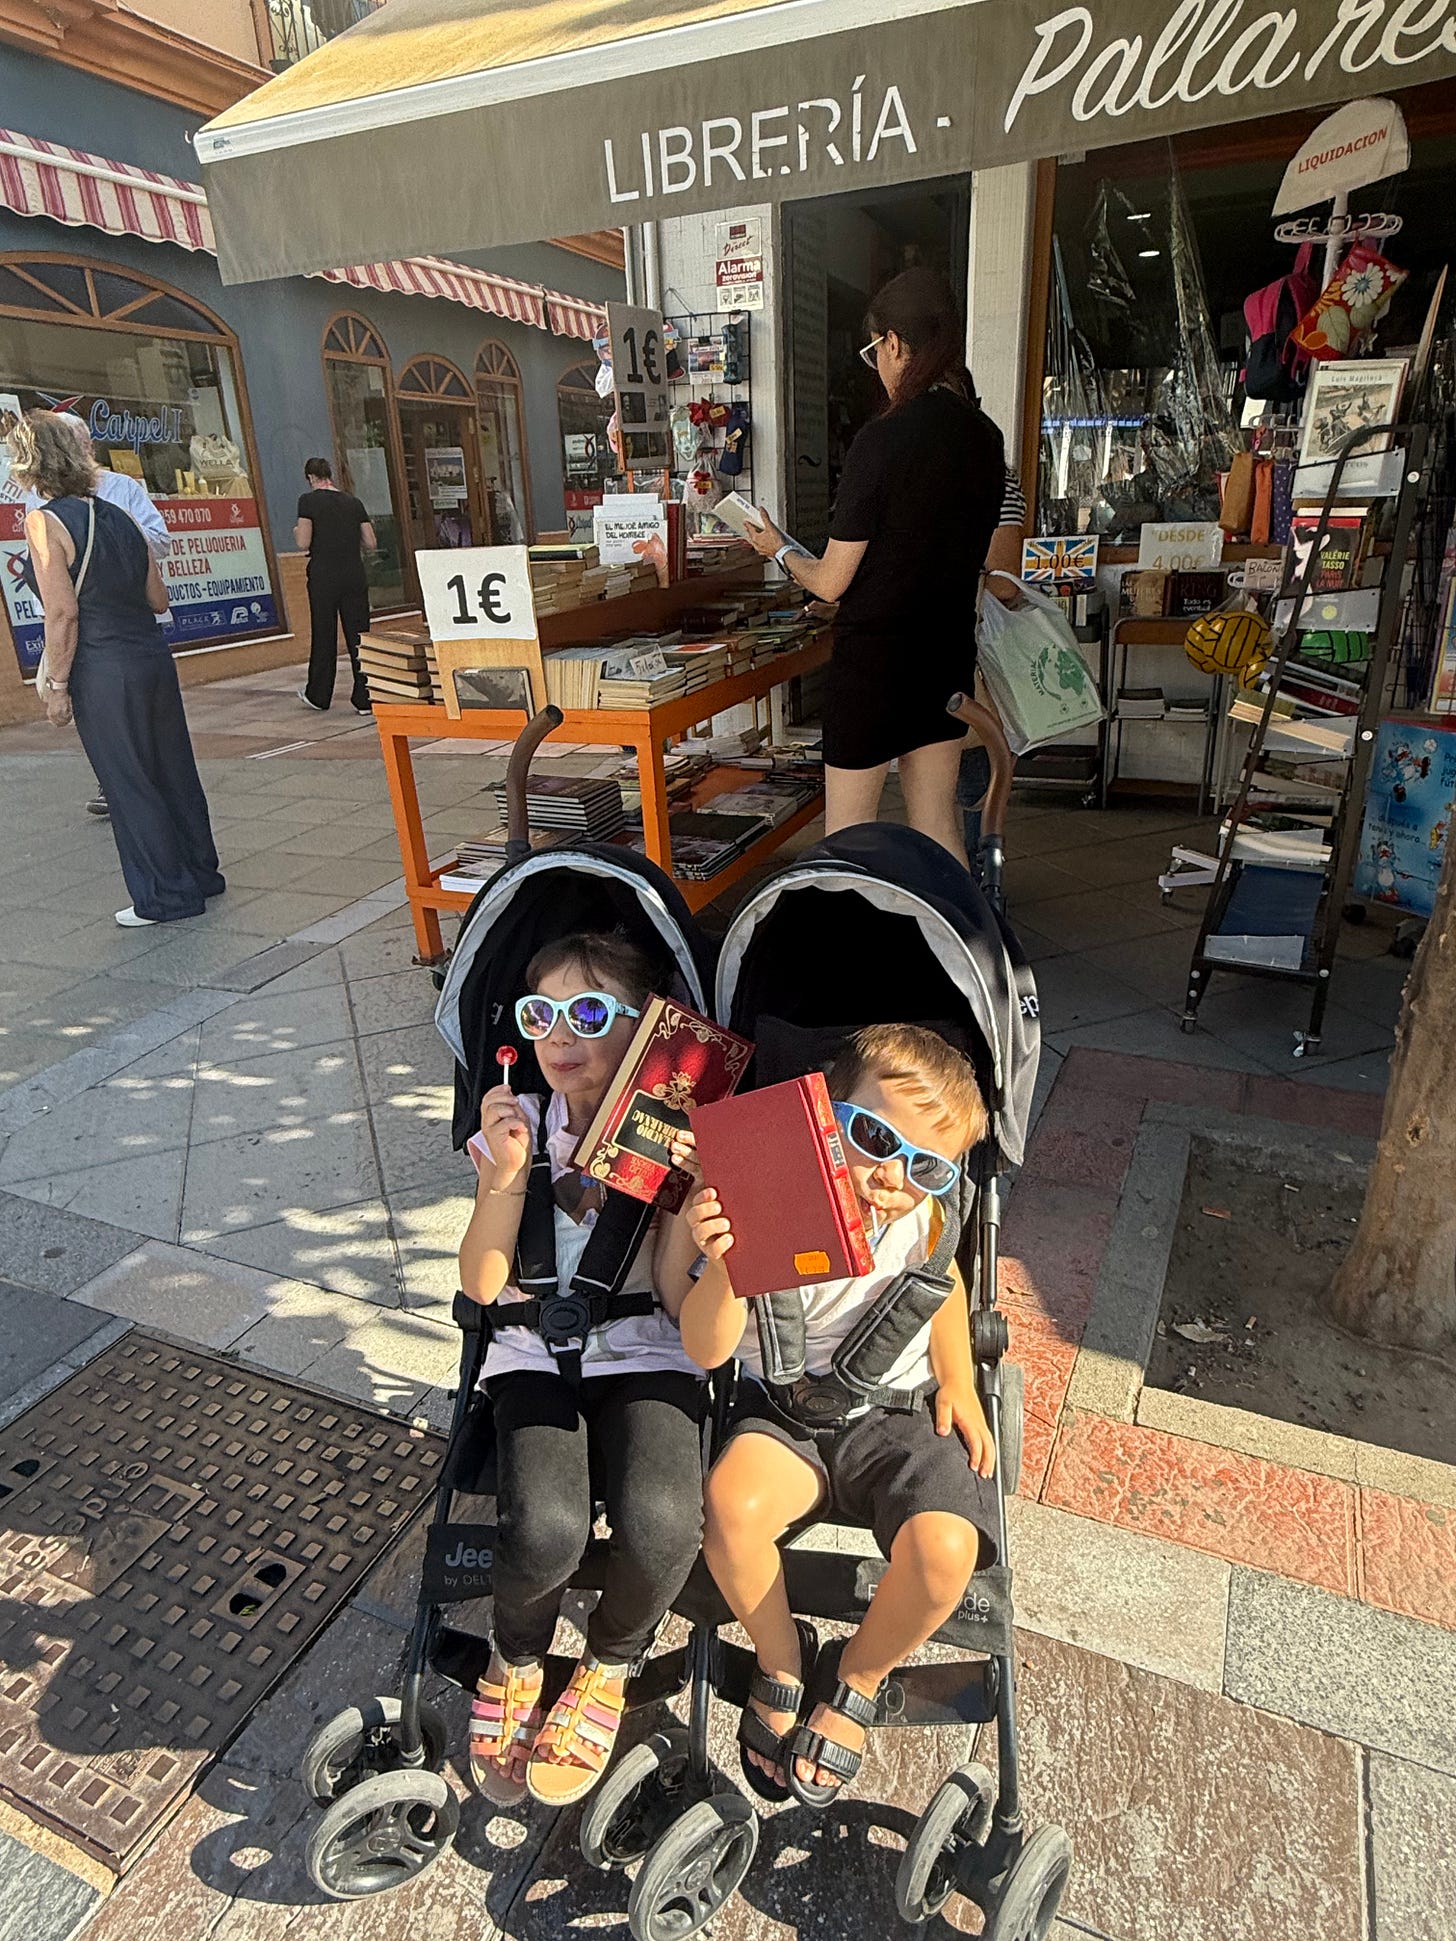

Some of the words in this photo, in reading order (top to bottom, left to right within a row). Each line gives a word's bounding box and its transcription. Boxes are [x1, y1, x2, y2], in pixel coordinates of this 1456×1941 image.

[1004, 0, 1456, 134] Pallare
[604, 74, 918, 204] LIBRERÍA
[1298, 127, 1388, 174] LIQUIDACION
[718, 260, 761, 276] Alarma
[623, 327, 662, 385] 1€
[90, 398, 171, 454] Carpel
[200, 459, 234, 467] WELLA
[178, 508, 195, 524] 470
[172, 539, 186, 555] DE
[187, 535, 247, 555] PELUQUERIA
[605, 531, 618, 539] DEL
[167, 558, 213, 578] BELLEZA
[1035, 553, 1086, 570] 1.00€
[1322, 561, 1345, 569] TASSO
[447, 572, 512, 625] 1€
[444, 1575, 458, 1588] by
